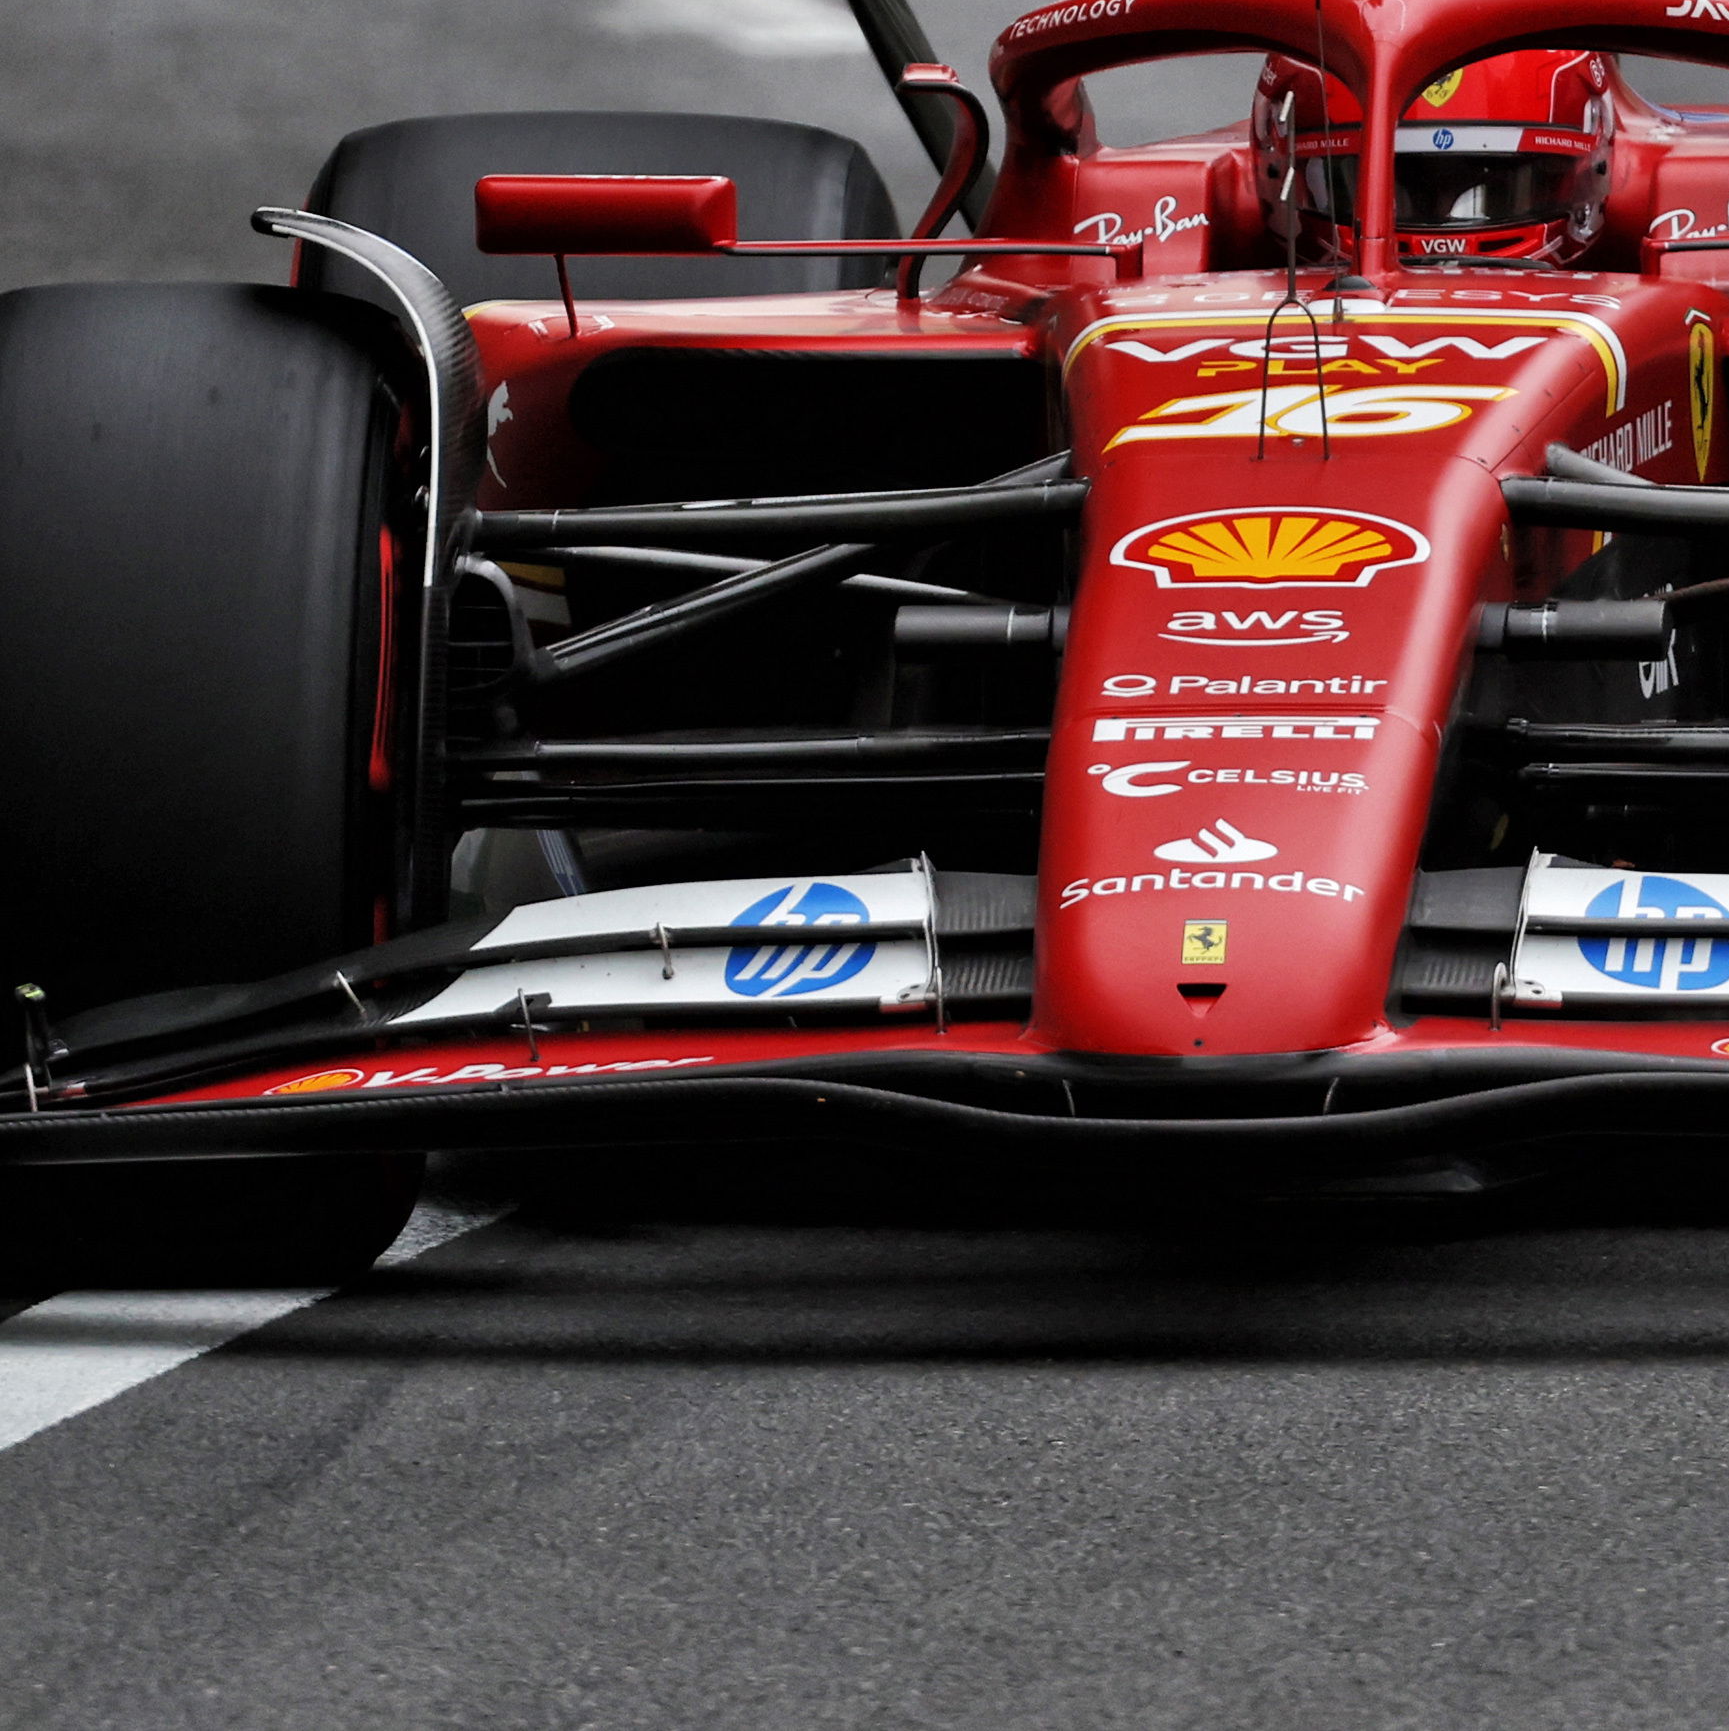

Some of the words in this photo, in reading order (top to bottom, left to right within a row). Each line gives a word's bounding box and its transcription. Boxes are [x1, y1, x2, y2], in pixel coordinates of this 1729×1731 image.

[1433, 129, 1454, 149] hp
[1421, 238, 1466, 254] VGW
[1103, 335, 1549, 362] VGW
[1196, 358, 1446, 378] PLAY
[1101, 383, 1521, 454] 16
[1636, 399, 1672, 466] MILLE
[1167, 608, 1344, 631] aws
[1169, 674, 1388, 695] Palantir
[1092, 716, 1381, 742] PIRELLI
[1187, 768, 1367, 788] CELSIUS
[1296, 784, 1332, 793] LIVE
[1336, 787, 1363, 795] FIT
[1059, 868, 1364, 909] Santander
[733, 881, 862, 998] hp
[1604, 875, 1724, 991] hp
